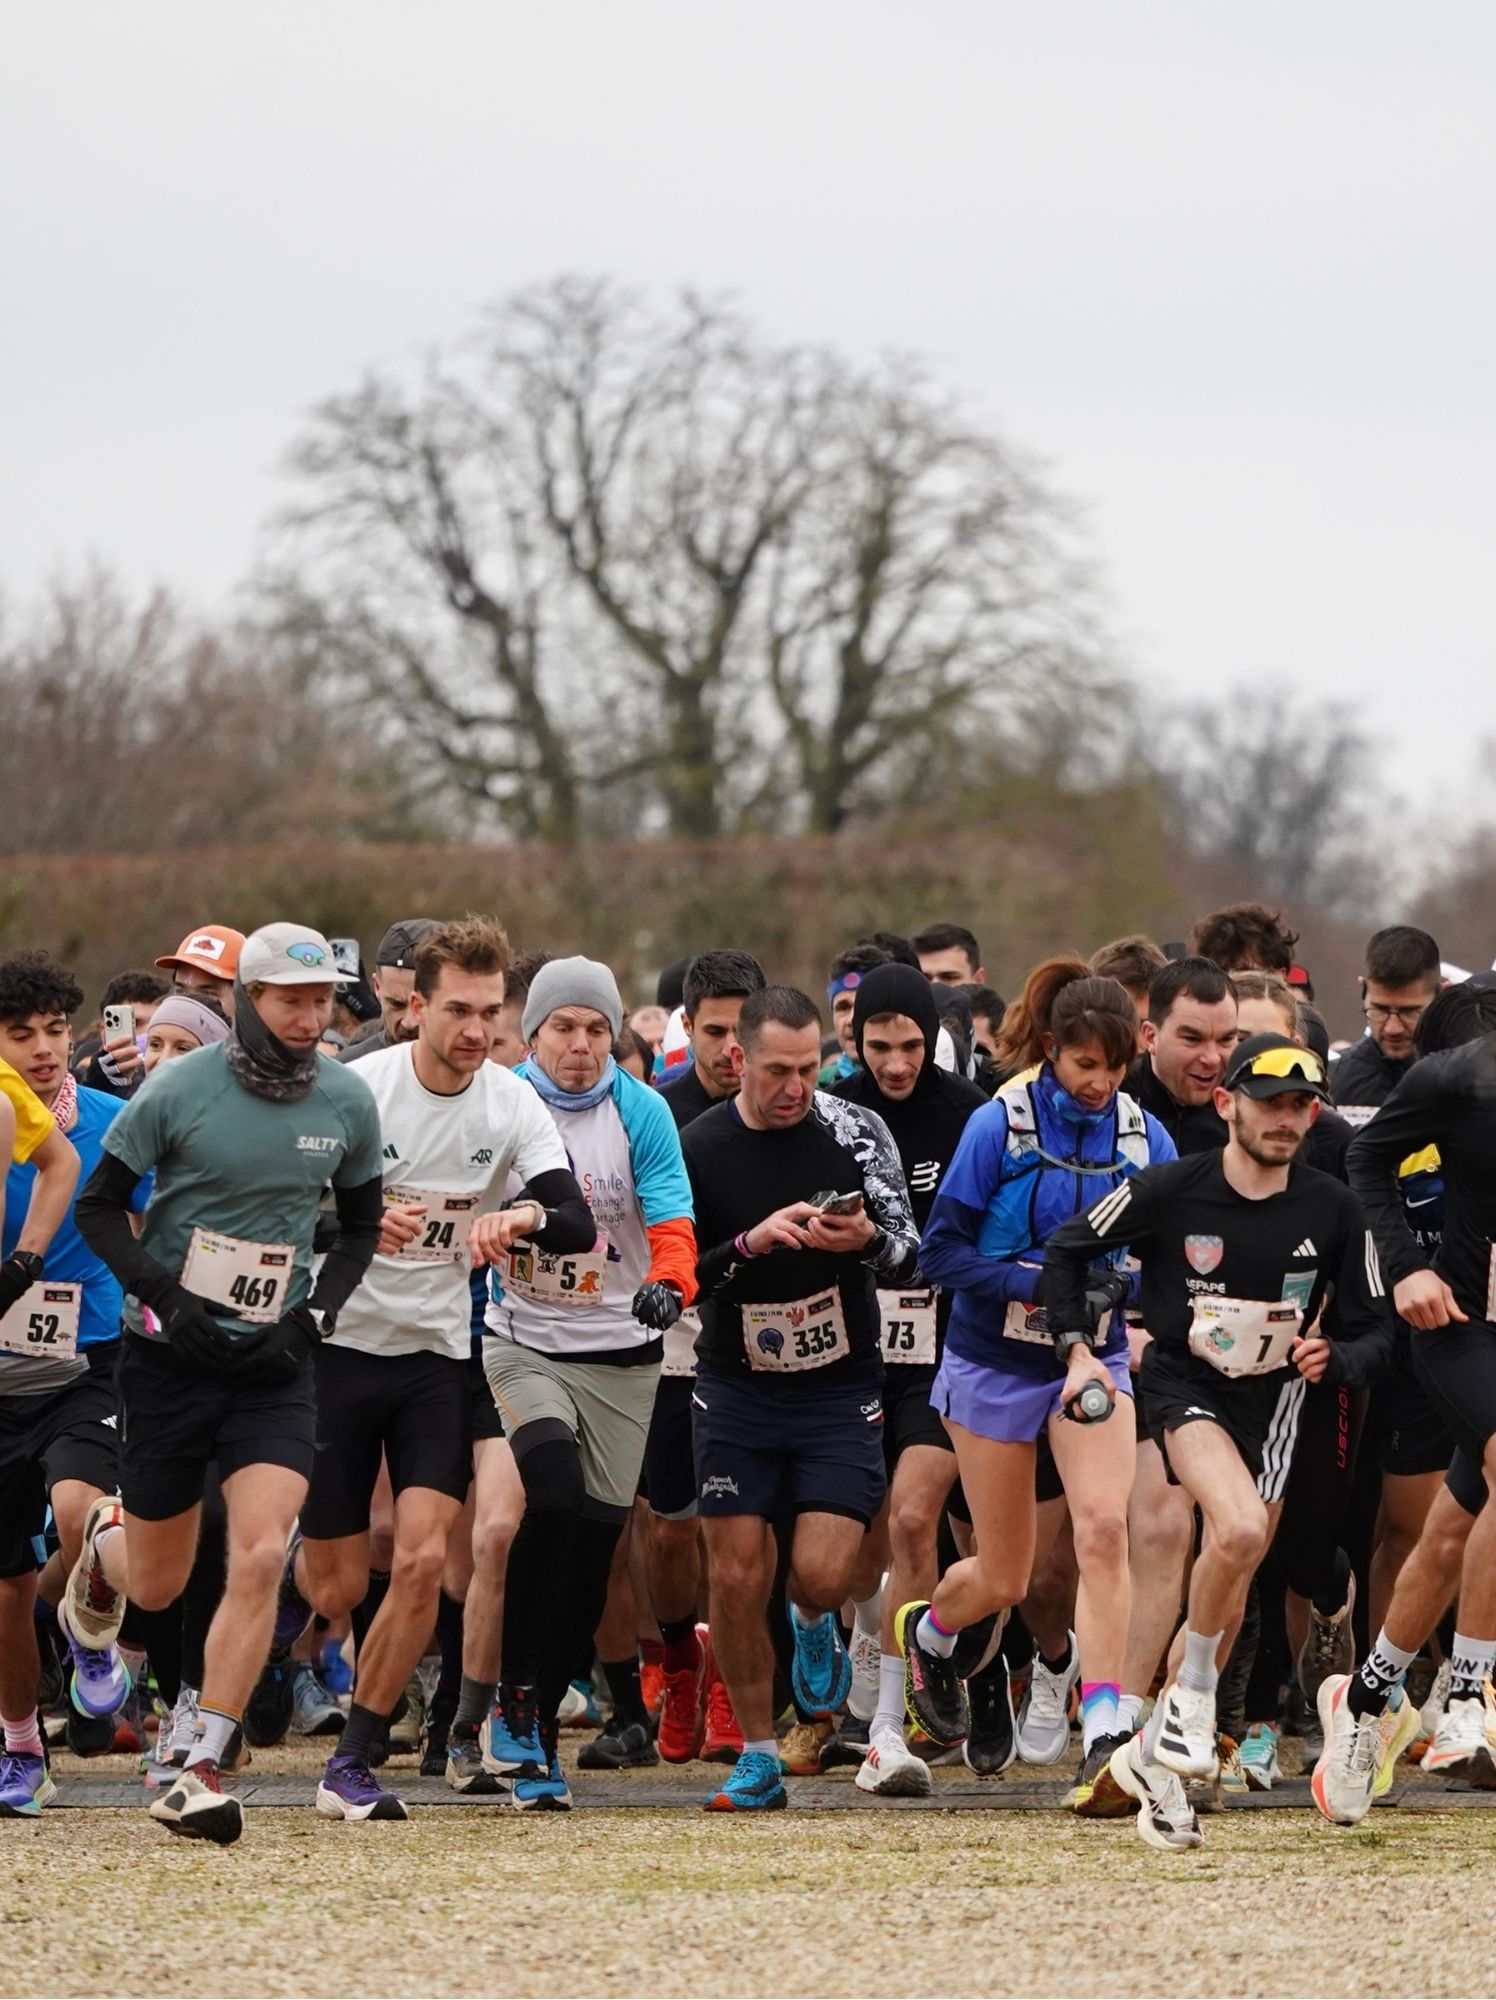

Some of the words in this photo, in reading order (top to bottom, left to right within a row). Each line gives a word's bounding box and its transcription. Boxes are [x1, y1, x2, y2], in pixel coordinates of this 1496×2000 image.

[296, 1135, 340, 1152] SALTY
[583, 1173, 624, 1191] Smile
[422, 1220, 455, 1249] 24
[594, 1212, 626, 1229] artage
[560, 1261, 577, 1291] 5
[1185, 1278, 1226, 1295] LEPAPE
[229, 1274, 278, 1309] 469
[27, 1313, 60, 1344] 52
[792, 1319, 838, 1359] 335
[887, 1321, 915, 1350] 73
[1256, 1334, 1274, 1363] 7
